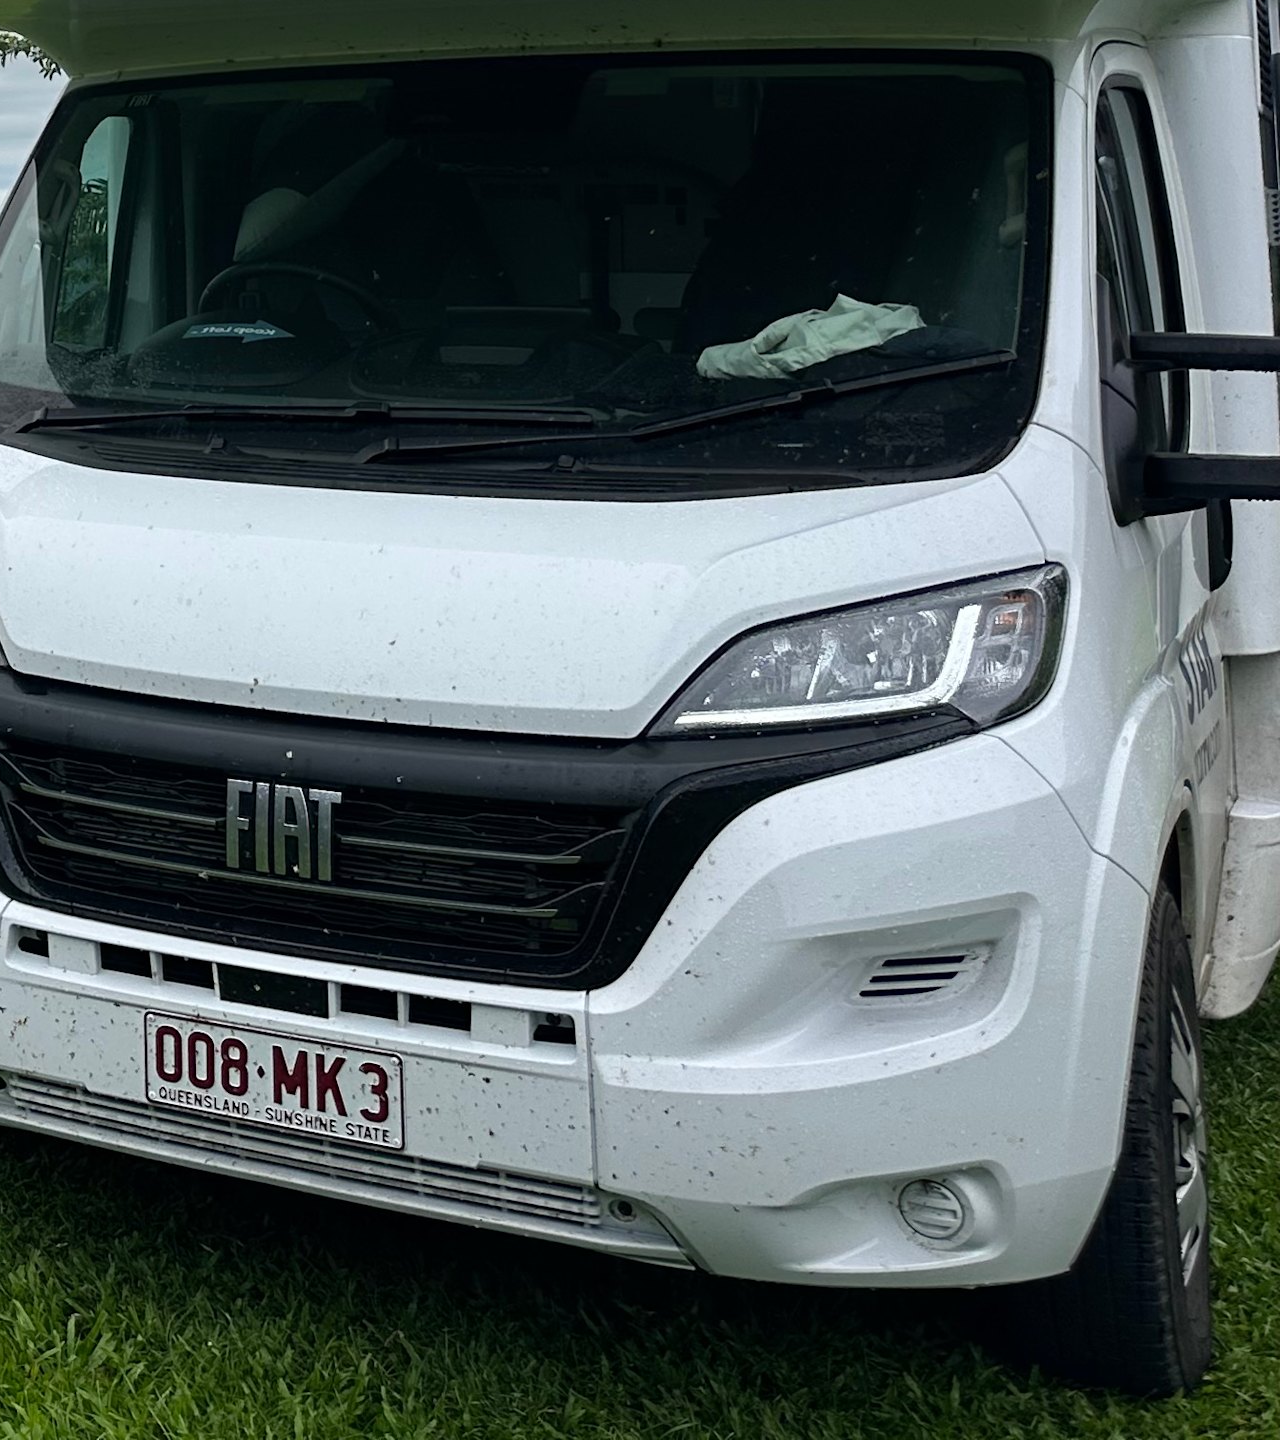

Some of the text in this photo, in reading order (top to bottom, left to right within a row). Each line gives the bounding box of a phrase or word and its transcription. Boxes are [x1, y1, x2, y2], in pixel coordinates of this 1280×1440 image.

[227, 778, 342, 881] FIAT
[159, 1087, 249, 1116] QUEENSLAND
[265, 1107, 337, 1133] SUNSHINE
[346, 1123, 390, 1143] STATE
